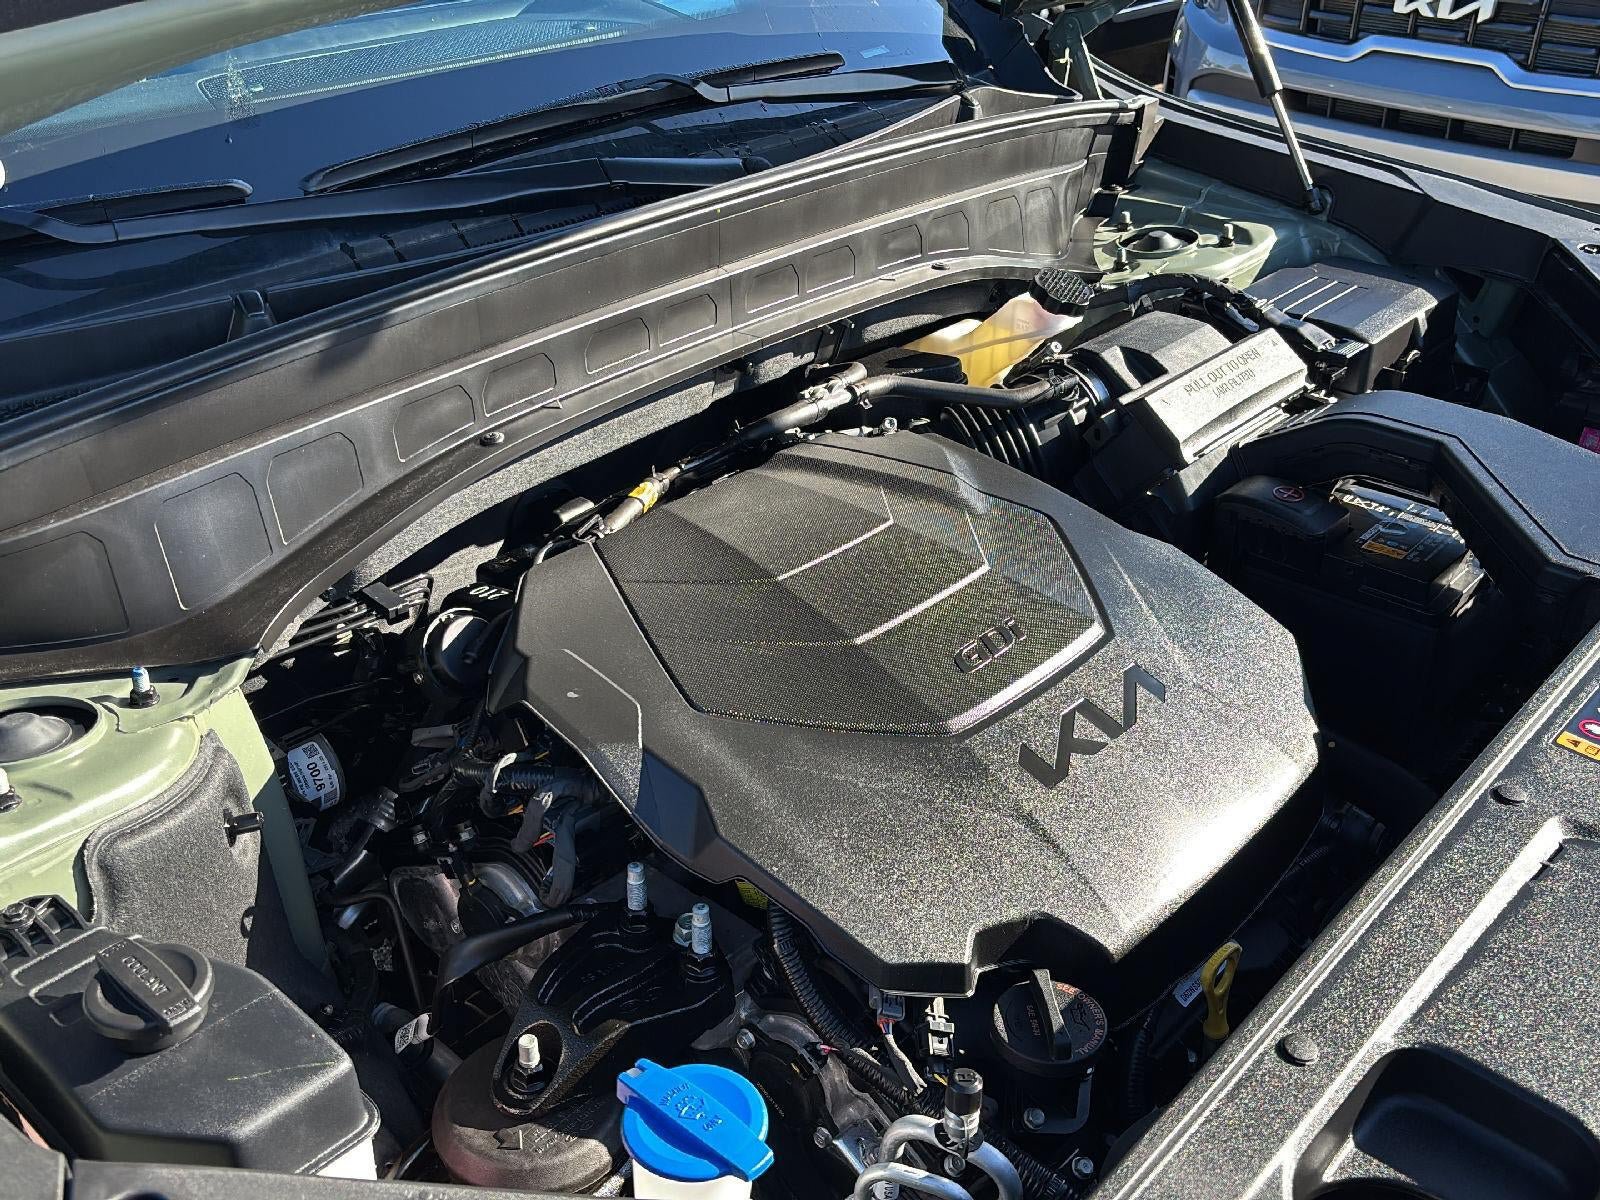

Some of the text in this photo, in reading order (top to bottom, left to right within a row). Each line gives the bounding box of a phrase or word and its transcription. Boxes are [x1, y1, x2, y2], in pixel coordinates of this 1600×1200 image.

[1183, 347, 1262, 397] PULL OUT TO OPEN
[306, 762, 326, 792] 9700
[122, 955, 171, 996] COOLANT
[1055, 982, 1105, 1055] SEE OWNER'S MANUAL
